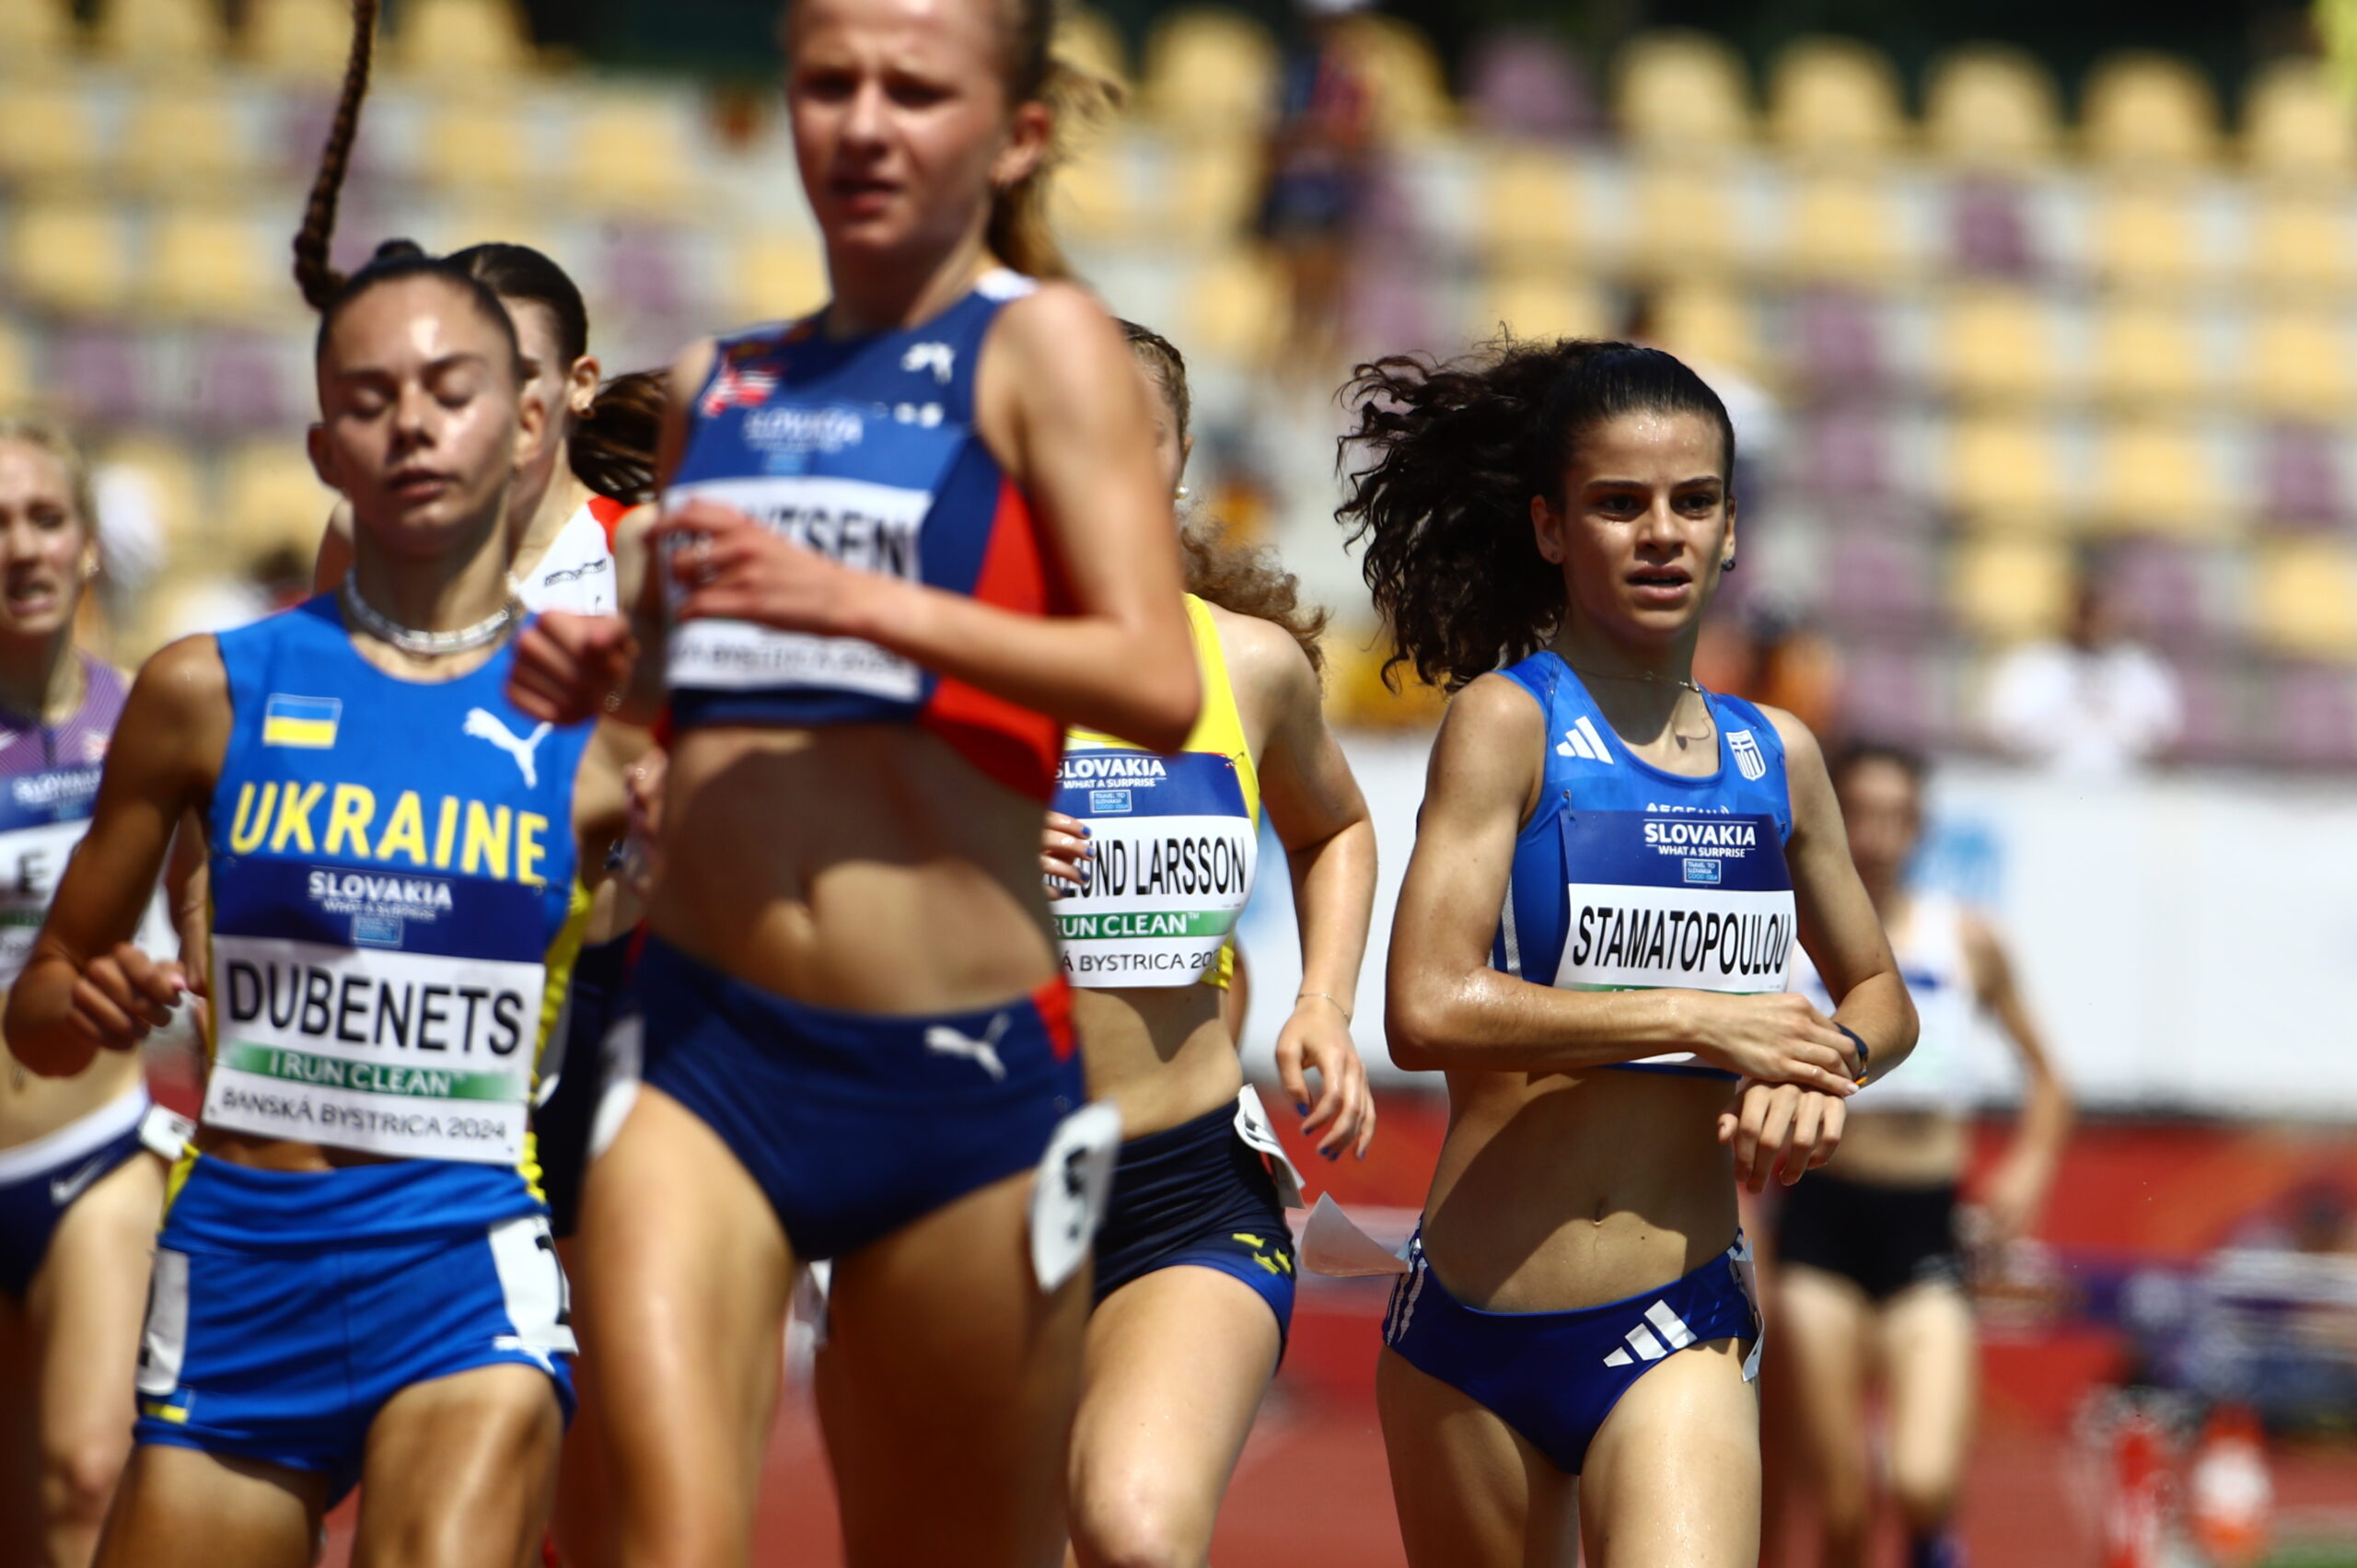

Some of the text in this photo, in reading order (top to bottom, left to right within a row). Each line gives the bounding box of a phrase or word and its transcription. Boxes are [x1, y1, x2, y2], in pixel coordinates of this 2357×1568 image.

[1063, 778, 1155, 789] WHAT A SURPRISE
[230, 782, 549, 886] UKRAINE
[1644, 823, 1756, 845] SLOVAKIA
[1658, 846, 1746, 857] WHAT A SURPRISE
[1136, 837, 1246, 896] LARSSON
[308, 870, 453, 910] SLOVAKIA
[1573, 905, 1792, 975] STAMATOPOULOU
[1080, 953, 1185, 971] BYSTRICA
[226, 959, 523, 1056] DUBENETS
[270, 1051, 277, 1072] I
[284, 1052, 344, 1086] RUN
[222, 1087, 506, 1140] BANSKÁ BYSTRICA 2024
